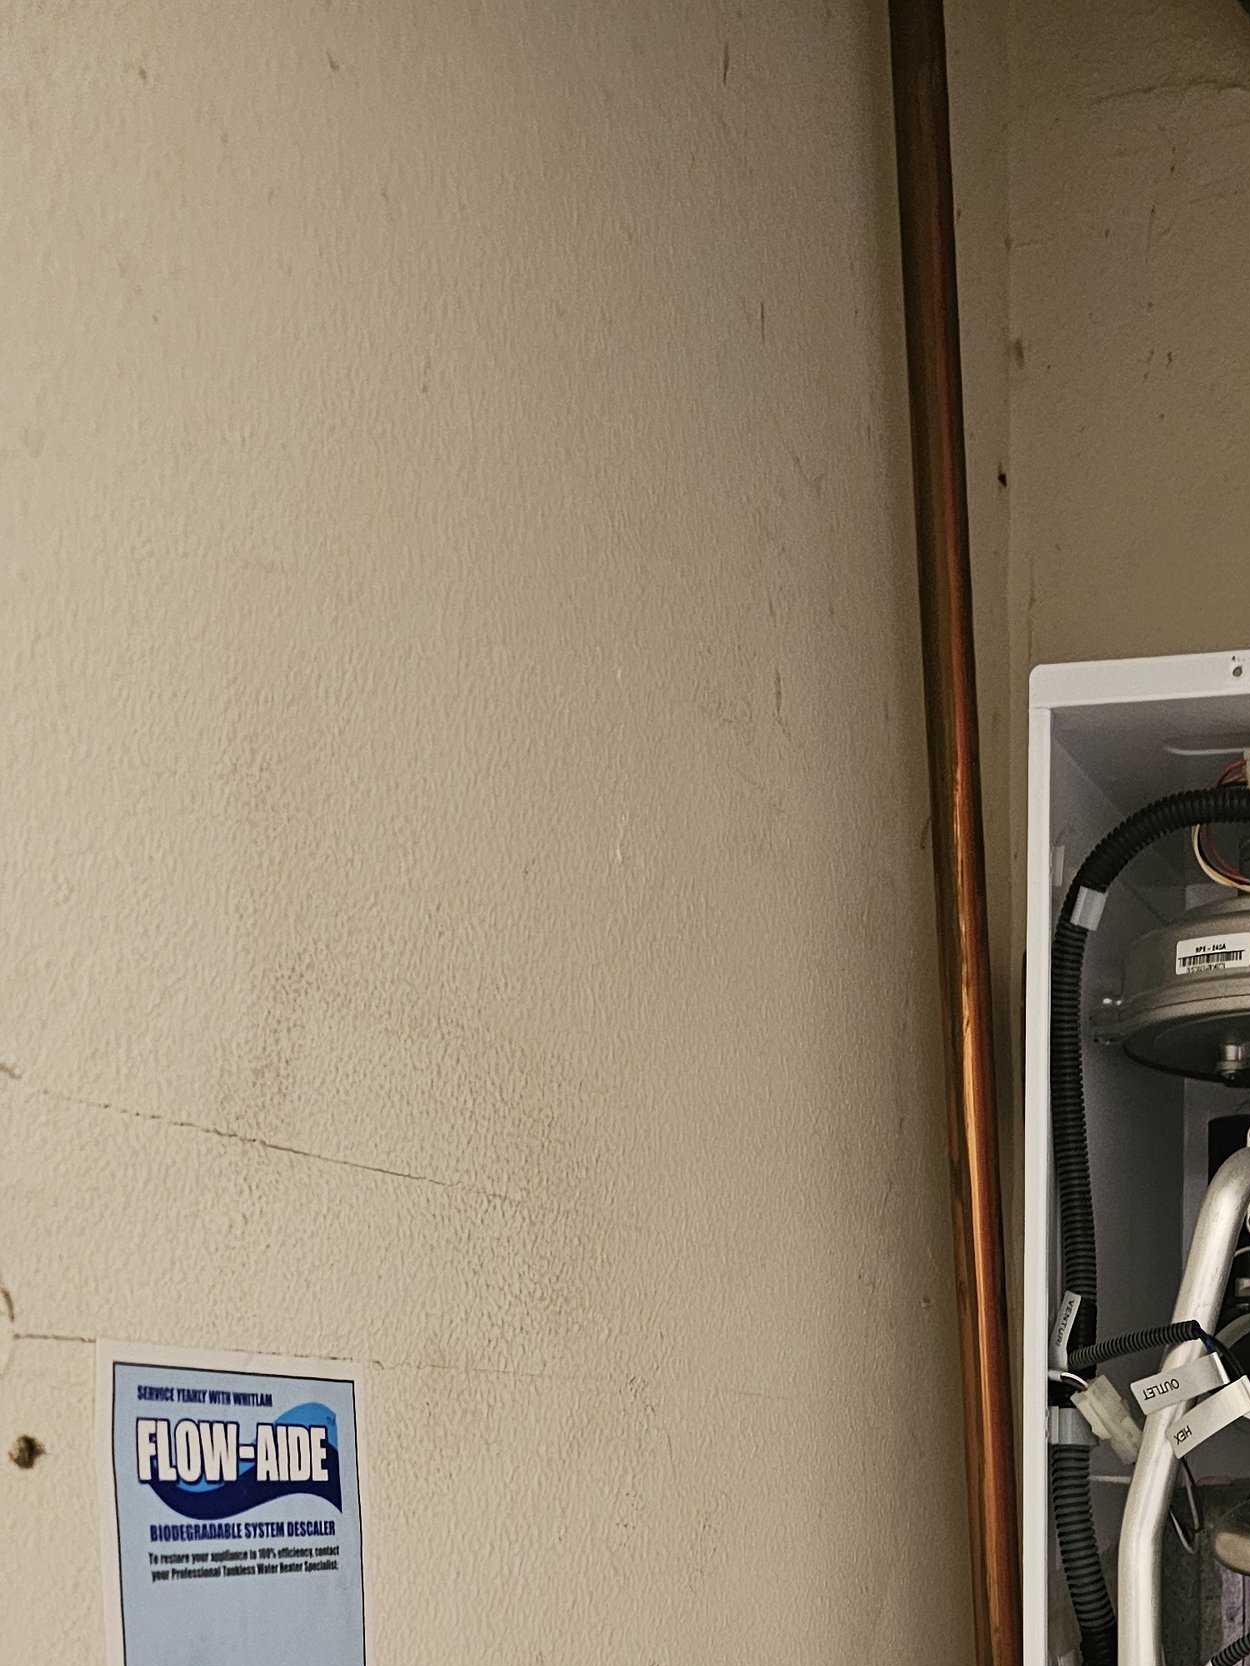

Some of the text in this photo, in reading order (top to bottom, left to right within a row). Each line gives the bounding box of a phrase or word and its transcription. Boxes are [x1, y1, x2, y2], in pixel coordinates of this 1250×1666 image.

[1055, 1299, 1074, 1347] VENTURI
[137, 1385, 273, 1407] SERVICE YEARLY WITH WHITLAM
[1142, 1378, 1180, 1401] OUTLET
[1173, 1425, 1192, 1445] HEX
[136, 1417, 329, 1484] FLOW-AIDE
[150, 1519, 336, 1542] BIODEGRADABLE SYSTEM DESCALER
[148, 1552, 158, 1565] To
[160, 1551, 189, 1565] restore
[191, 1552, 208, 1565] your
[210, 1549, 248, 1563] appliance
[314, 1545, 340, 1557] contact
[151, 1569, 170, 1583] your
[171, 1566, 221, 1581] Professional
[223, 1564, 256, 1577] Tankless
[256, 1562, 279, 1575] Water
[279, 1561, 303, 1574] Heater
